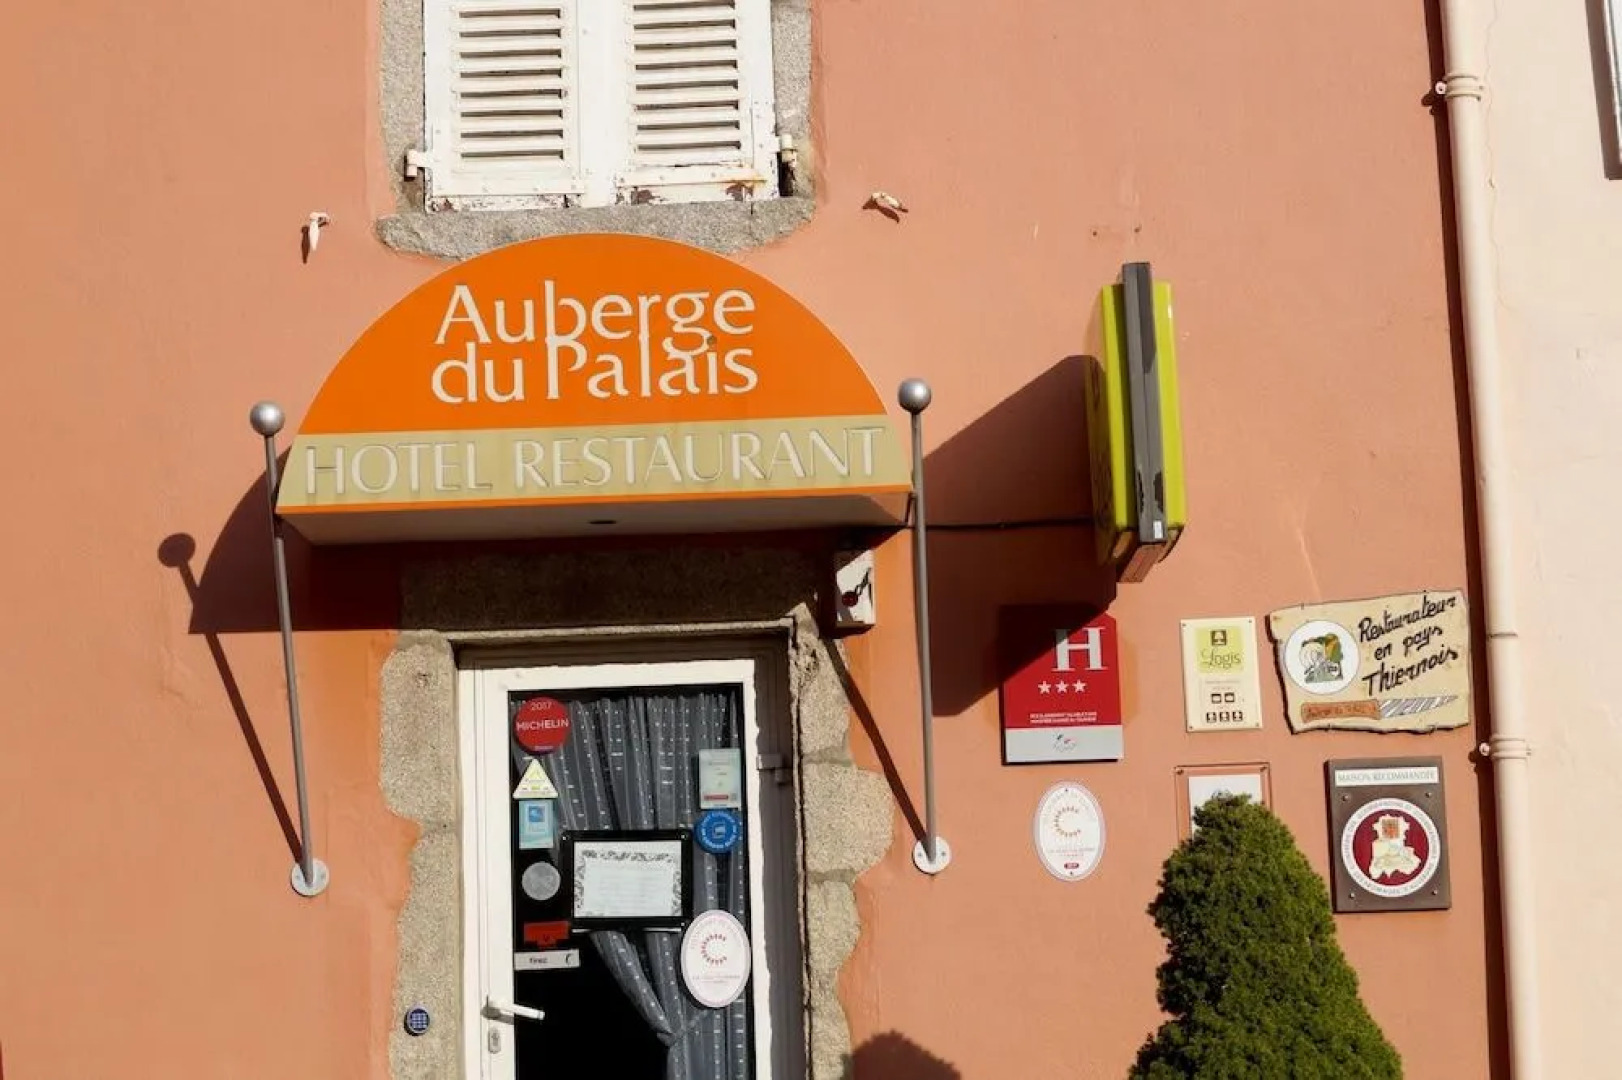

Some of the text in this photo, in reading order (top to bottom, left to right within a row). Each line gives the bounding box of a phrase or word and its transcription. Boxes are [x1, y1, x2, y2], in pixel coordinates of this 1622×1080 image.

[435, 280, 756, 357] Auberge
[430, 334, 760, 403] du Palais
[306, 426, 884, 495] HOTEL RESTAURANT
[1358, 594, 1456, 643] Restaurateur
[1374, 625, 1443, 661] en pays
[1052, 626, 1109, 671] H
[1362, 644, 1459, 697] Thiernois
[515, 718, 570, 732] MICHELIN
